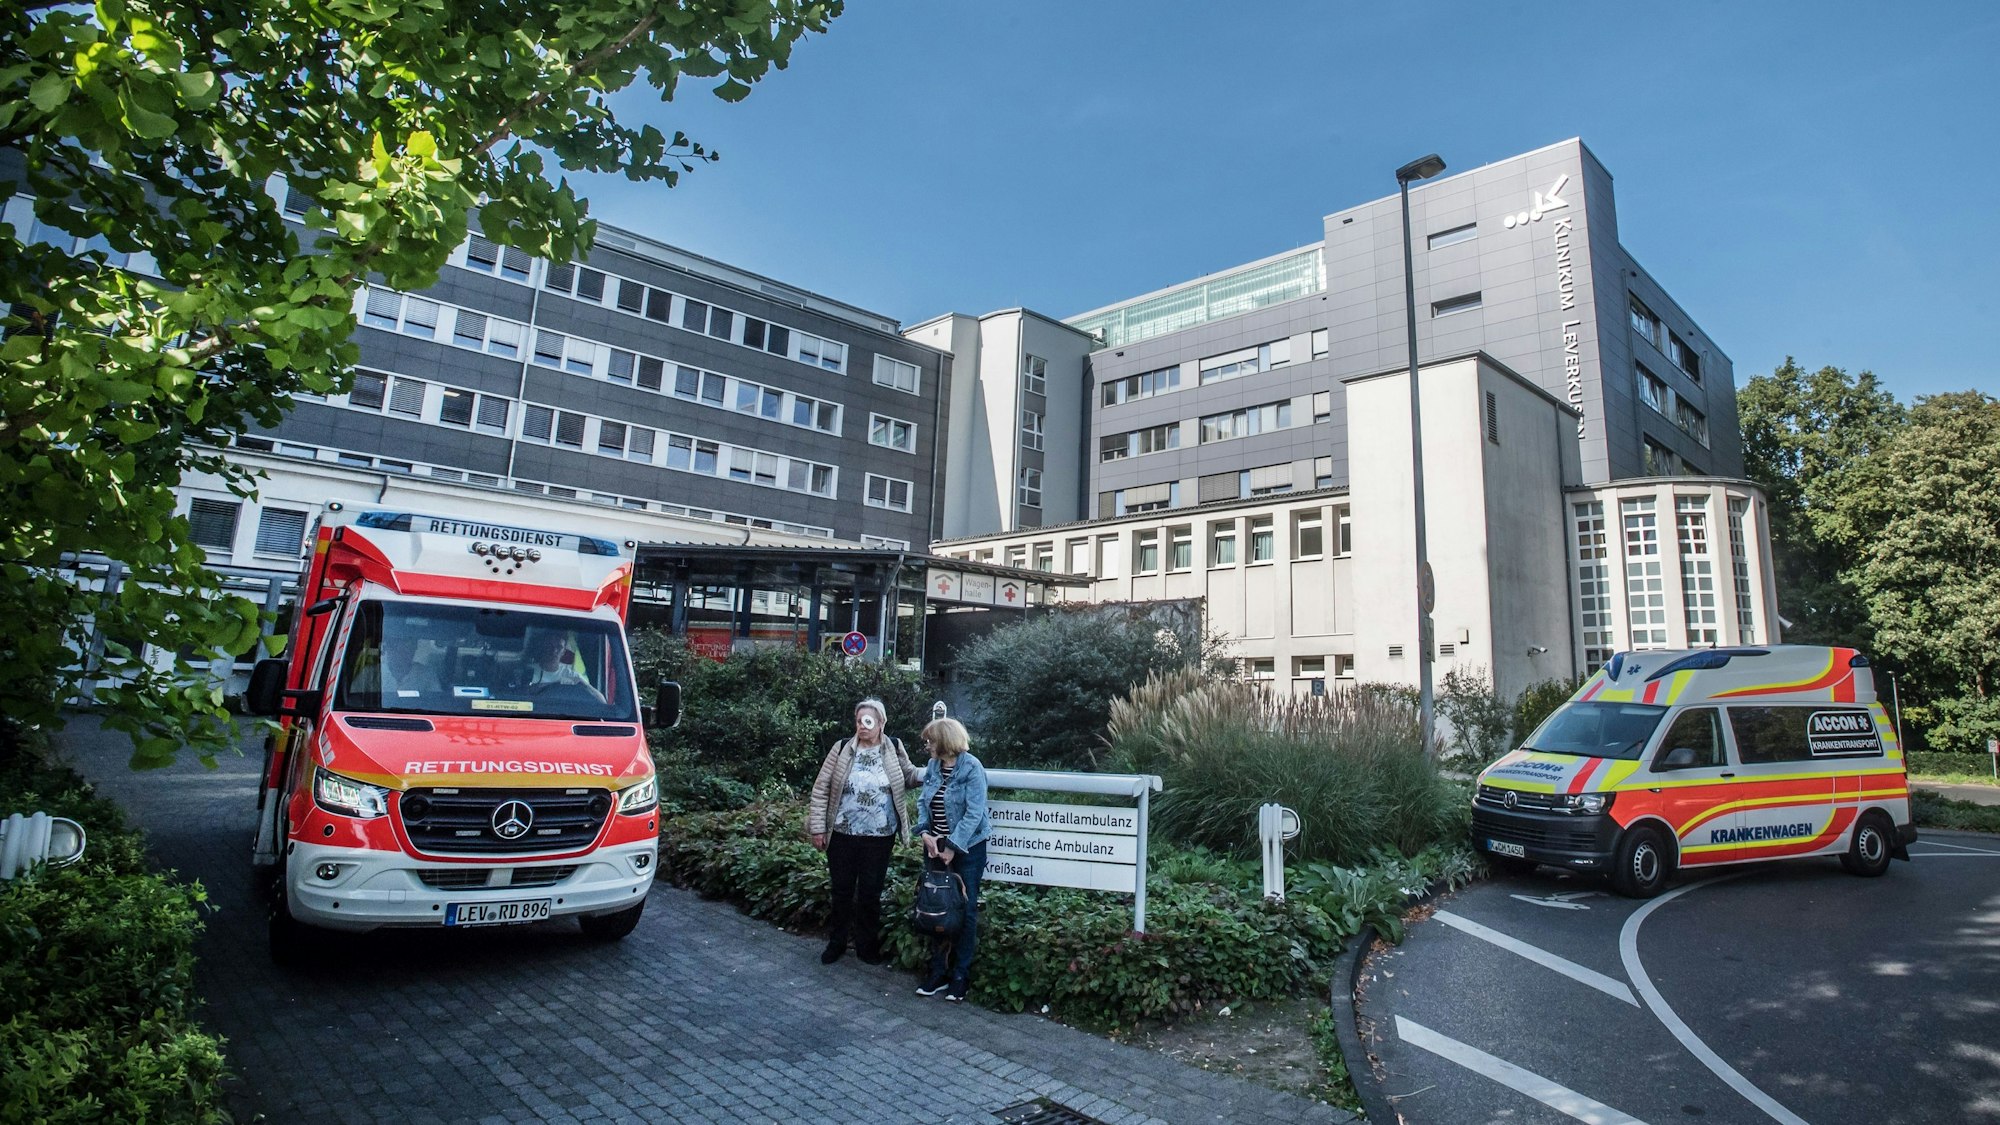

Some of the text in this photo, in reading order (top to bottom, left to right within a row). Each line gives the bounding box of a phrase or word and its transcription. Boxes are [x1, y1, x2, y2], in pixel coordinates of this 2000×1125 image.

[1554, 217, 1575, 312] KLINIKUM
[430, 519, 563, 547] RETTUNGSDIENST
[964, 588, 982, 598] halle
[965, 579, 992, 590] Wagen-
[1815, 716, 1859, 731] ACCON
[1812, 738, 1878, 750] KRANKENTRANSPORT
[404, 760, 614, 777] RETTUNGSDIENST
[1035, 810, 1132, 828] Notfallambulanz
[1711, 822, 1813, 844] KRANKENWAGEN
[1054, 839, 1114, 856] Ambulanz
[457, 902, 549, 922] LEV RD 896
